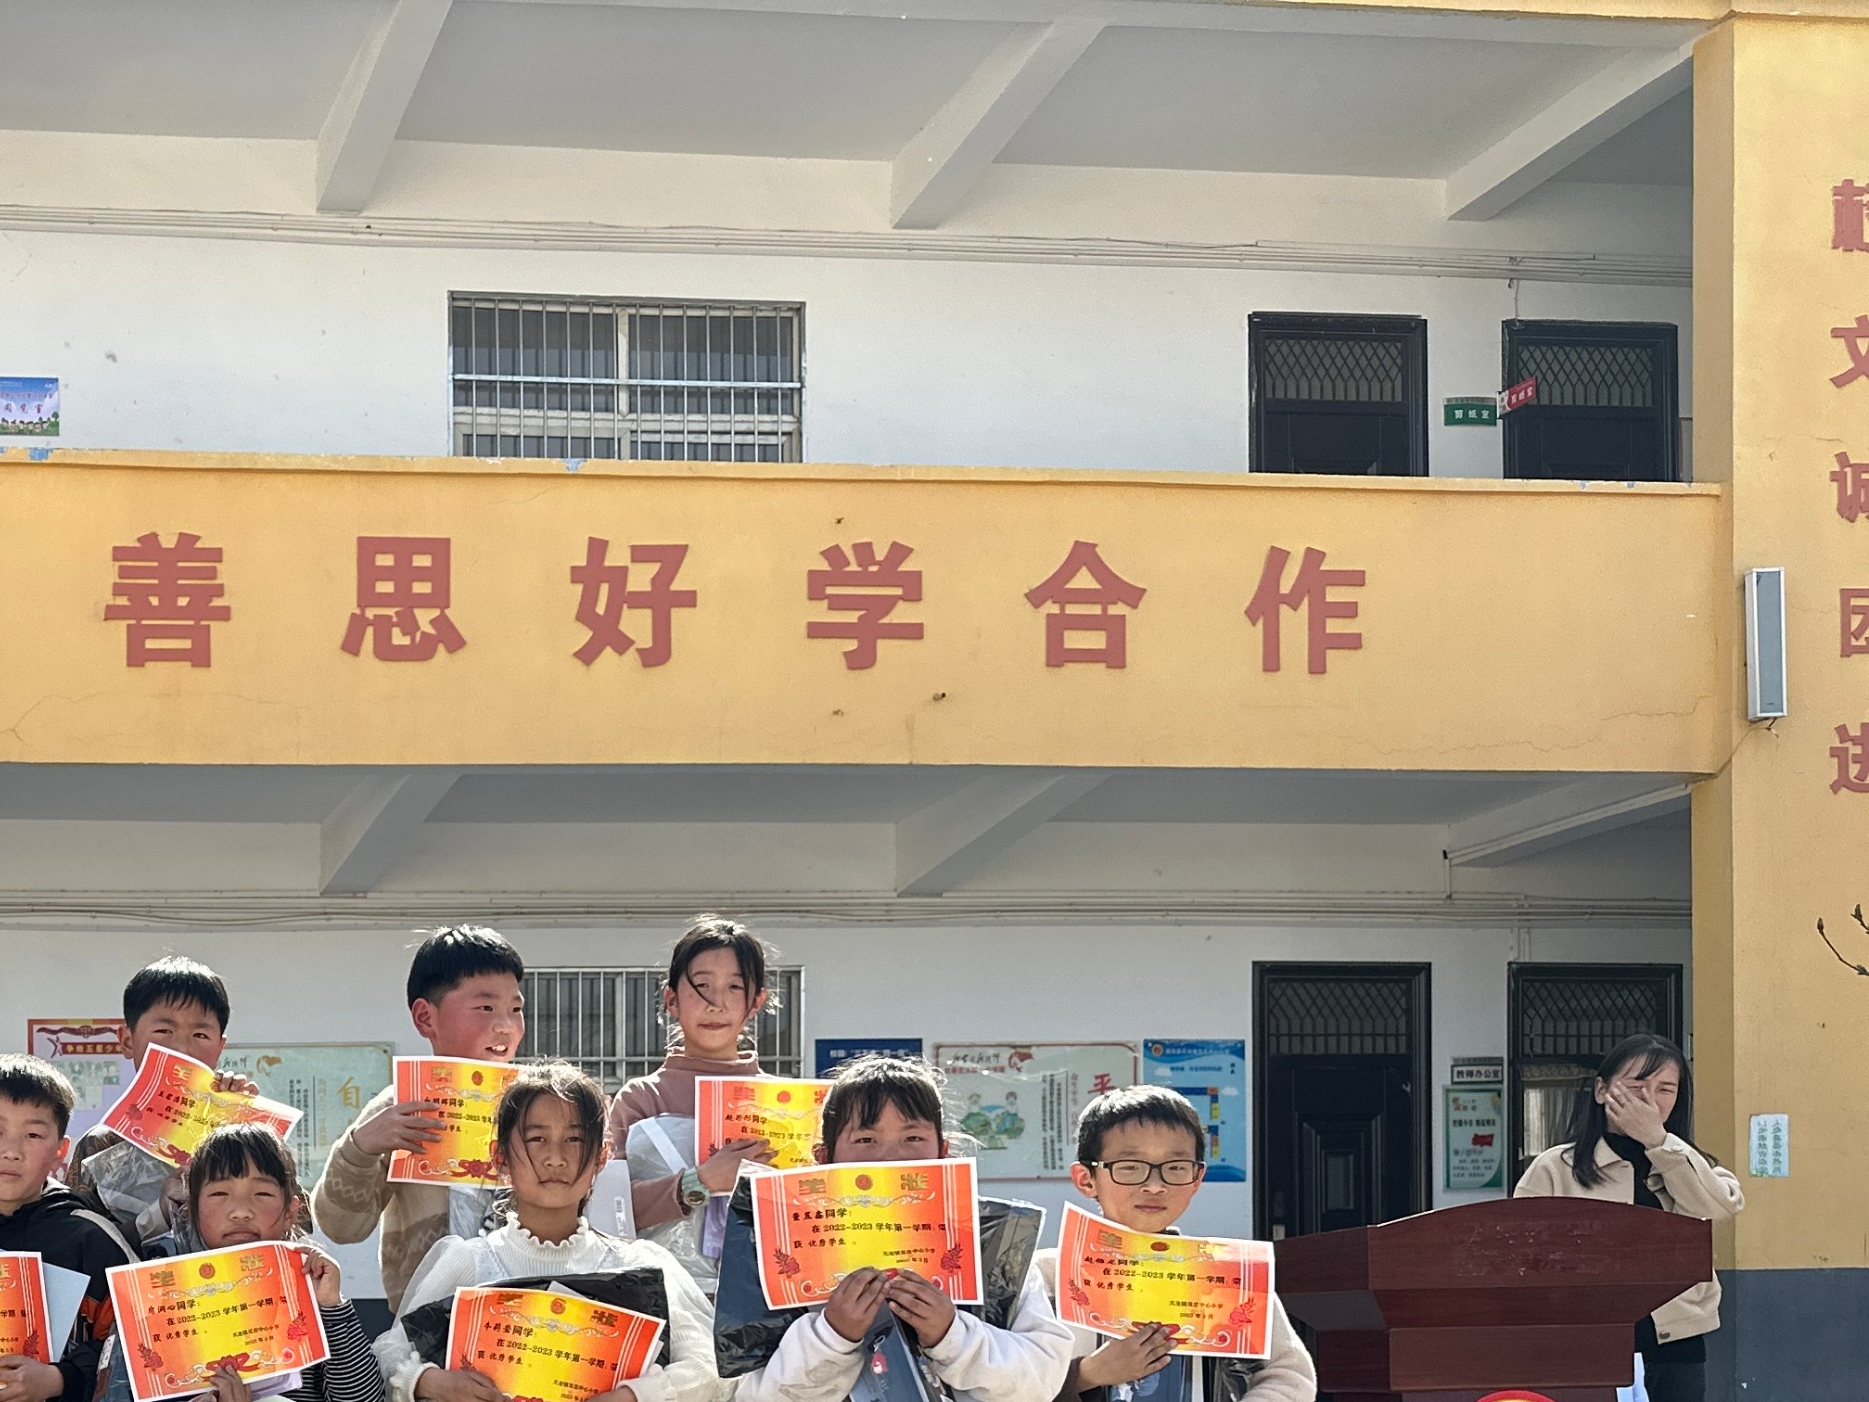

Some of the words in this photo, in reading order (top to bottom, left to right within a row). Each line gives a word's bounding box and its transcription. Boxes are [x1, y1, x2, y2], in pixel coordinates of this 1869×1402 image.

[1456, 1069, 1500, 1079] 教师办公室
[337, 1075, 361, 1110] 自
